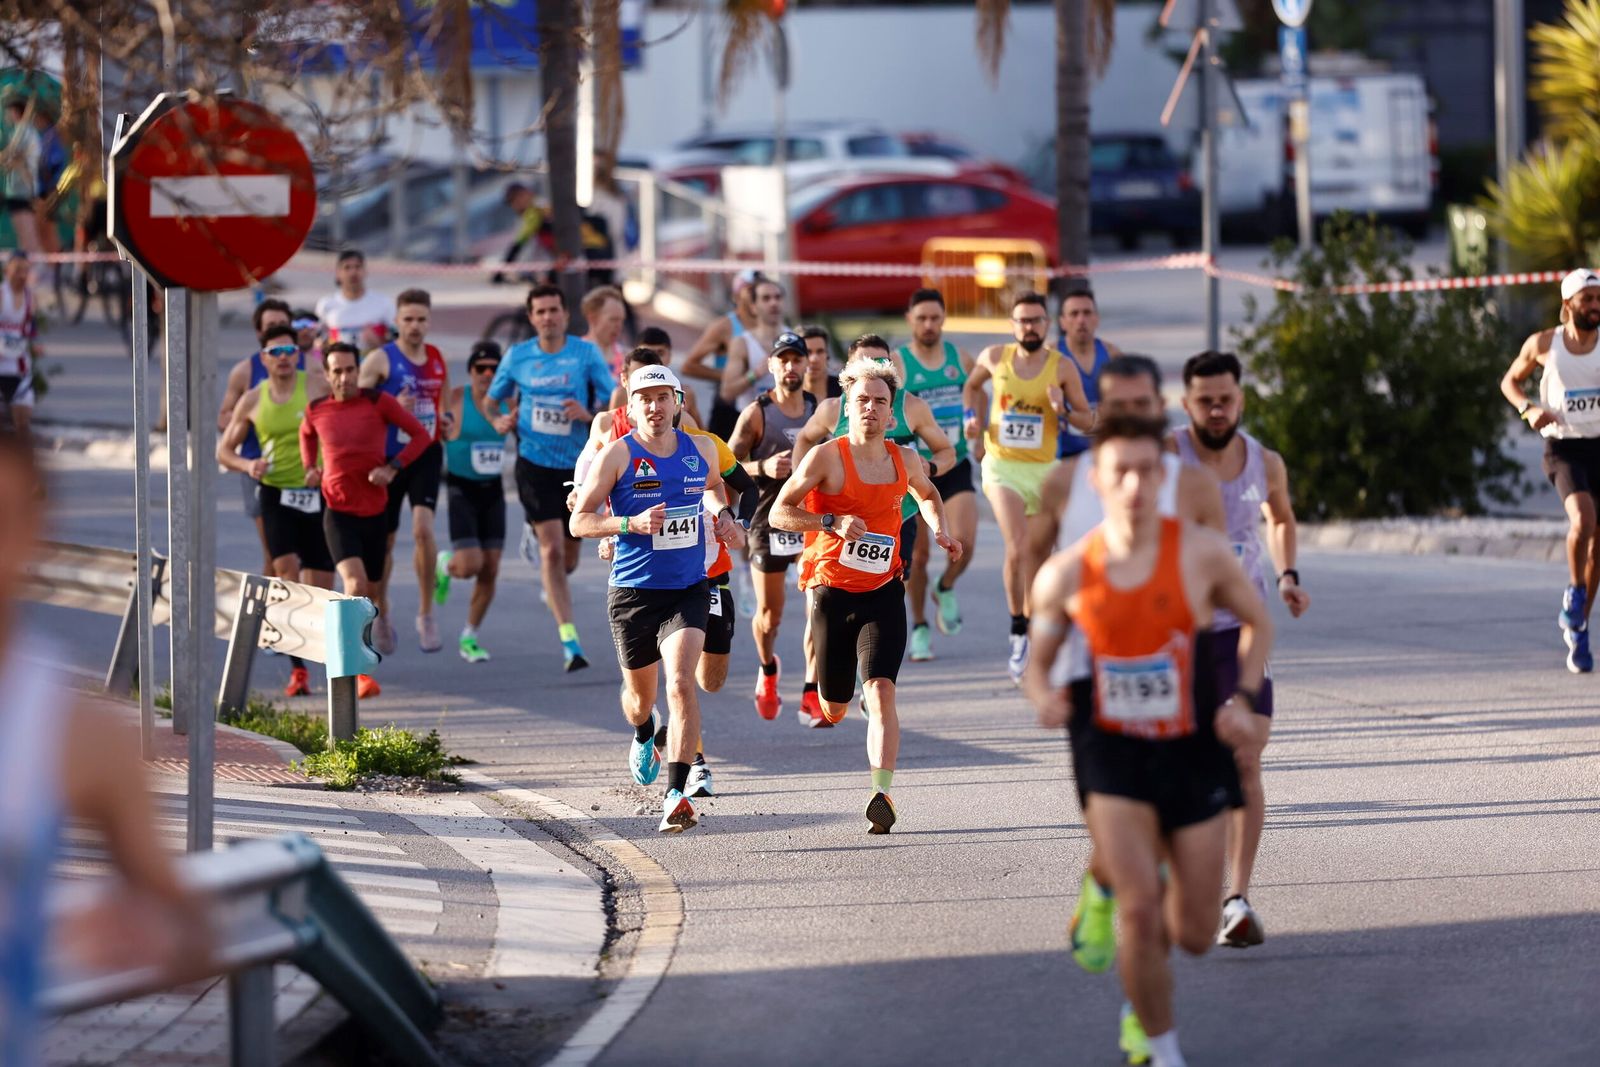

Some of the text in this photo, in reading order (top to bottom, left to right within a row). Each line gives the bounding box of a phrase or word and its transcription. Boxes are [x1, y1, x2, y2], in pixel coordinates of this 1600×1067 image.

[640, 372, 666, 381] HOKA
[1006, 424, 1034, 437] 475
[288, 493, 314, 506] 327
[659, 517, 696, 537] 1441
[847, 541, 891, 562] 1684
